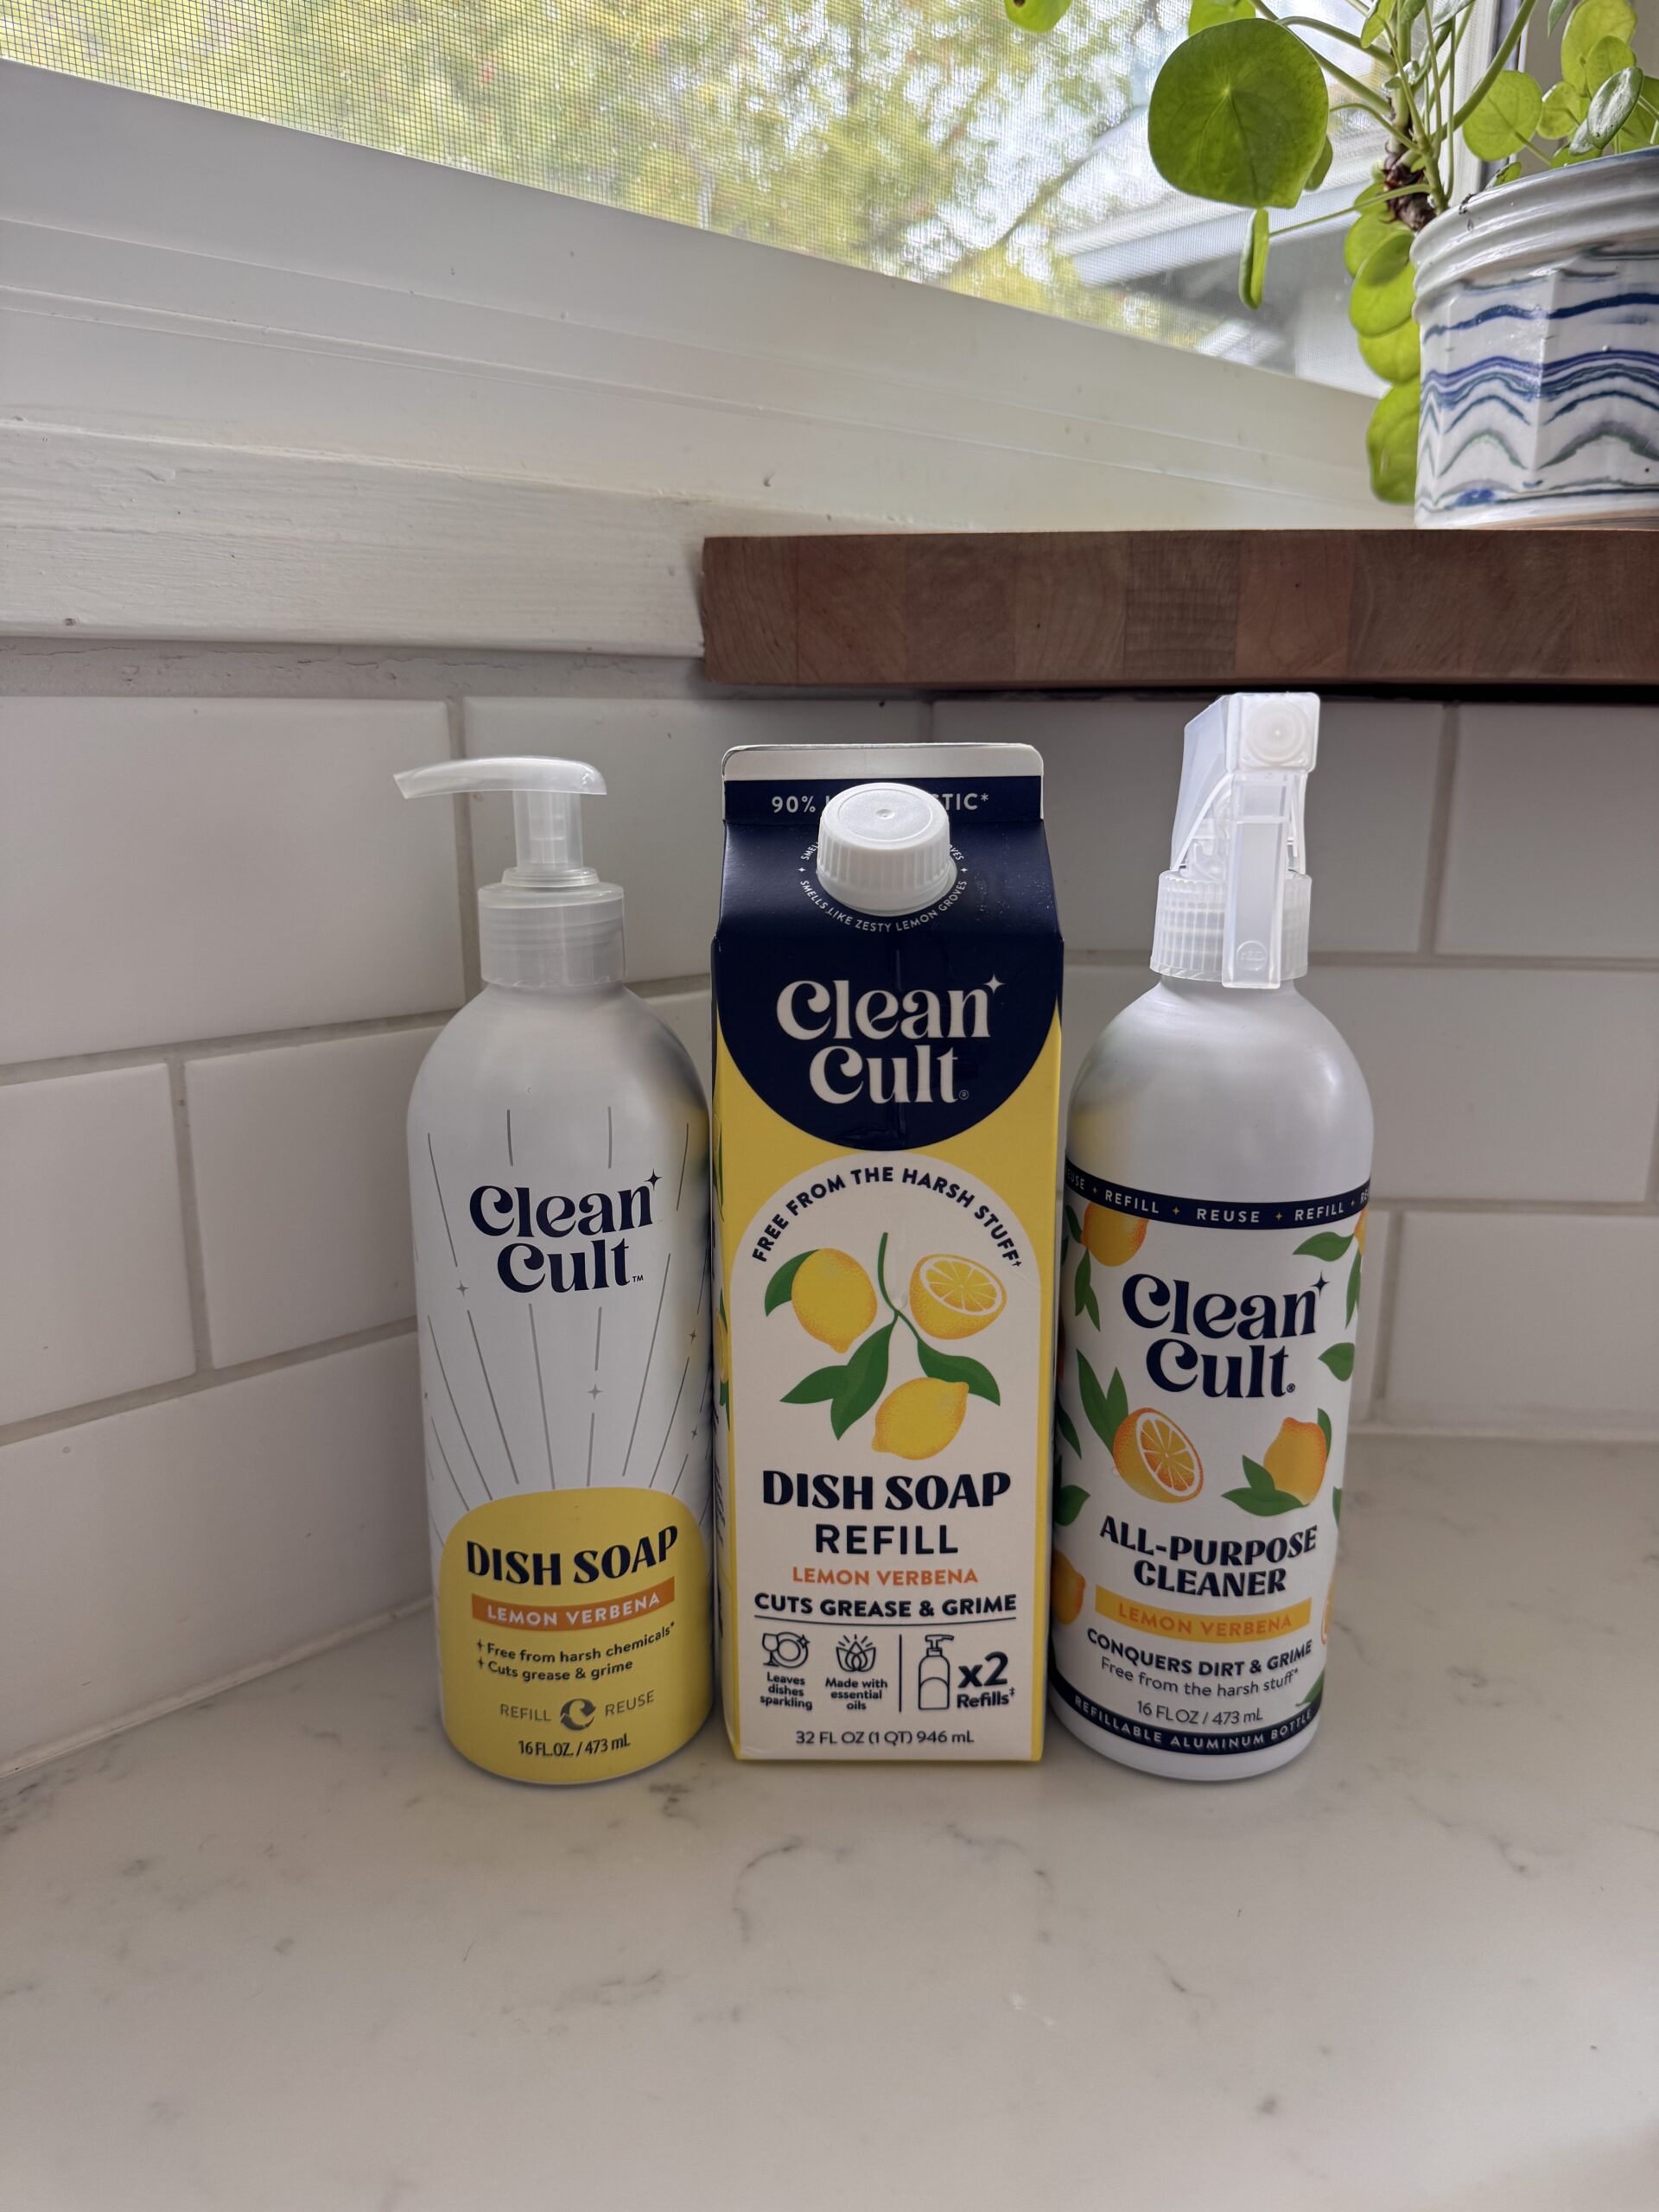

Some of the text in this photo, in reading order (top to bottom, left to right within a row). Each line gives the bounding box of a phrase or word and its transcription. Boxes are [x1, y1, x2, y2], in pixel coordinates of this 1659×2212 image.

[771, 795, 817, 813] 90%
[800, 880, 968, 933] SMELLS LIKE ZESTY LEMON GROVES
[776, 979, 991, 1040] Clean
[469, 1185, 654, 1238] Clean
[1066, 1167, 1344, 1224] EUSE REFILL REUSE REFILL
[751, 1213, 790, 1262] FREE
[785, 1173, 847, 1216] FROM
[850, 1166, 894, 1185] THE
[901, 1167, 976, 1208] HARSH
[1122, 1273, 1316, 1340] Clean
[762, 1470, 874, 1510] DISH
[885, 1471, 1012, 1510] SOAP
[467, 1524, 678, 1586] DISH SOAP
[816, 1523, 959, 1555] REFILL
[1099, 1515, 1318, 1567] ALL-PURPOSE
[791, 1566, 979, 1586] LEMON VERBENA
[1134, 1560, 1287, 1598] CLEANER
[487, 1592, 660, 1626] LEMON VERBENA
[753, 1592, 1017, 1618] CUTS GREASE & GRIME
[1118, 1602, 1293, 1637] LEMON VERBENA
[487, 1642, 516, 1660] Free
[519, 1649, 556, 1663] from
[560, 1647, 601, 1662] harsh
[957, 1650, 1009, 1688] x2
[1087, 1628, 1313, 1677] CONQUERS DIRT & GRIME
[488, 1660, 633, 1682] Cuts grease & grime
[766, 1671, 805, 1686] Leaves
[824, 1677, 888, 1689] Made with
[1101, 1656, 1135, 1681] Free
[1138, 1672, 1179, 1693] from
[1184, 1681, 1212, 1697] the
[1217, 1680, 1259, 1697] harsh
[500, 1689, 655, 1722] REFILL REUSE
[760, 1694, 813, 1712] sparkling
[767, 1683, 804, 1698] dishes
[830, 1688, 883, 1700] essential
[846, 1700, 867, 1711] oils
[1074, 1694, 1313, 1750] REFILLABLE ALUMINUM BOTTLE
[1137, 1700, 1263, 1726] 16 FL OZ / 473 mL
[518, 1739, 533, 1755] 16
[575, 1742, 583, 1758] /
[585, 1738, 608, 1754] 473
[611, 1733, 632, 1750] mL
[795, 1730, 975, 1746] 32 FL OZ (1 QT) 946 mL
